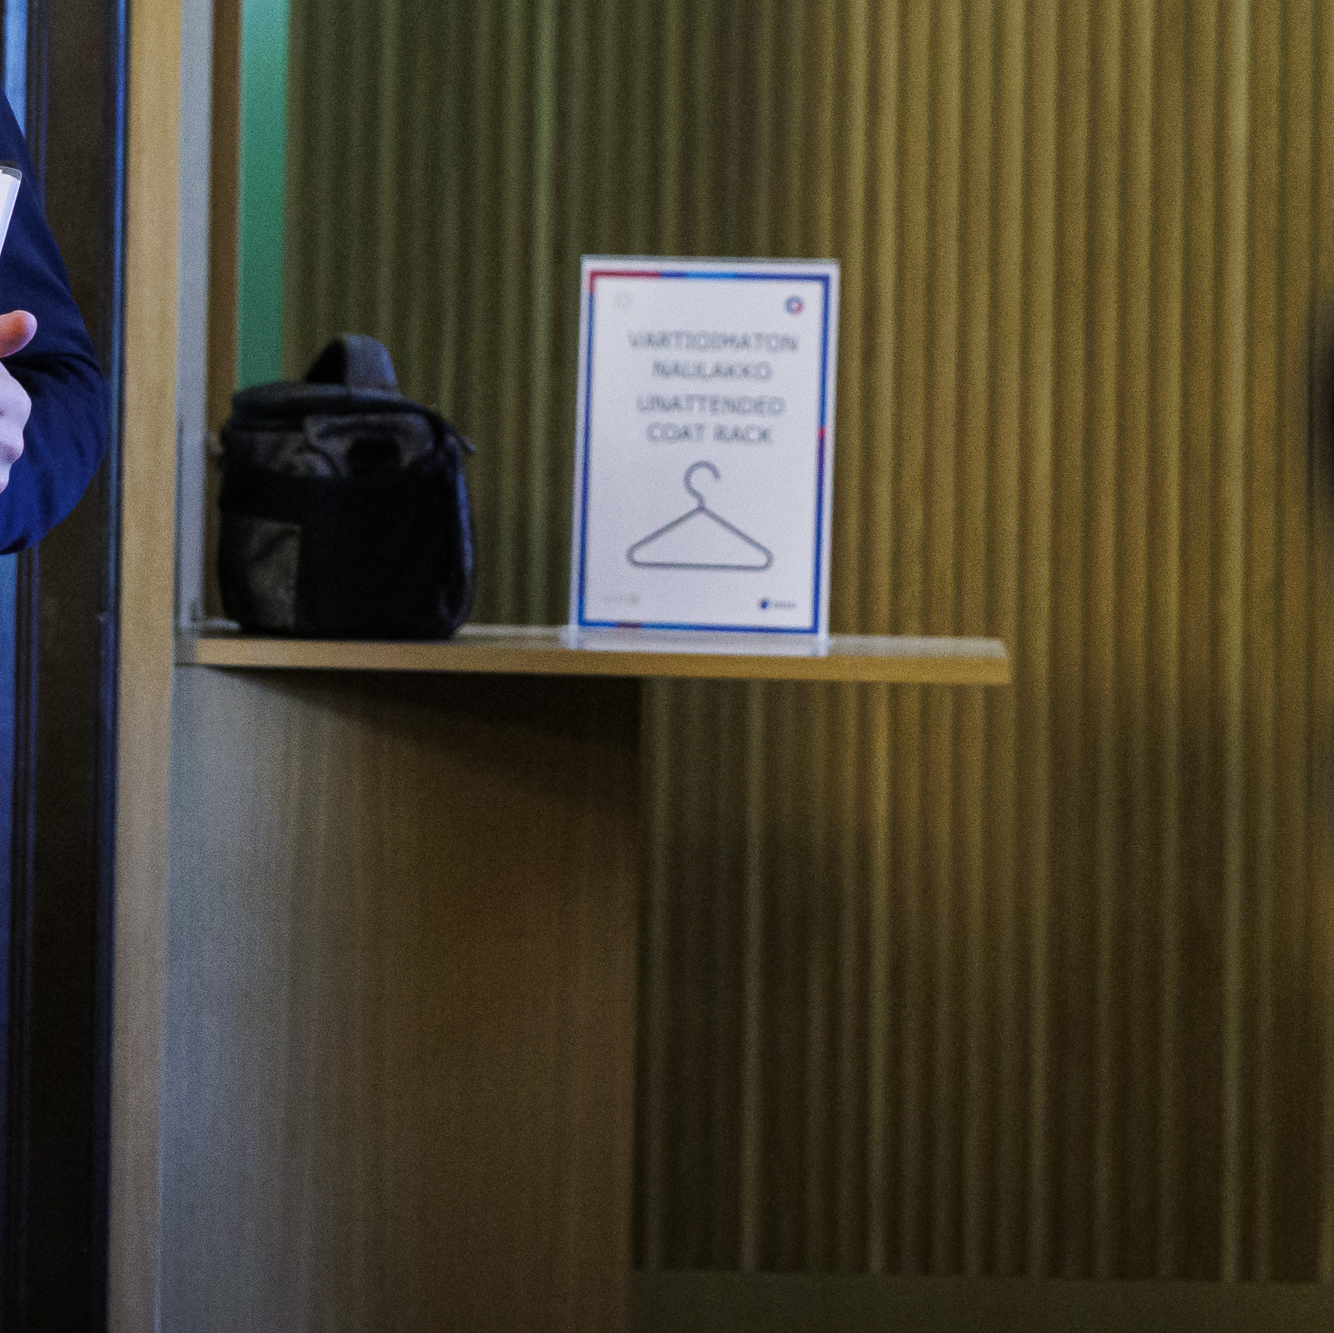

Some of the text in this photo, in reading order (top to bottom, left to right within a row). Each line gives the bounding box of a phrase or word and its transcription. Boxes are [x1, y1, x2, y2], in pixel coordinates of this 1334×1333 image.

[637, 394, 786, 415] UNATTENDED
[646, 422, 772, 443] COAT RACK
